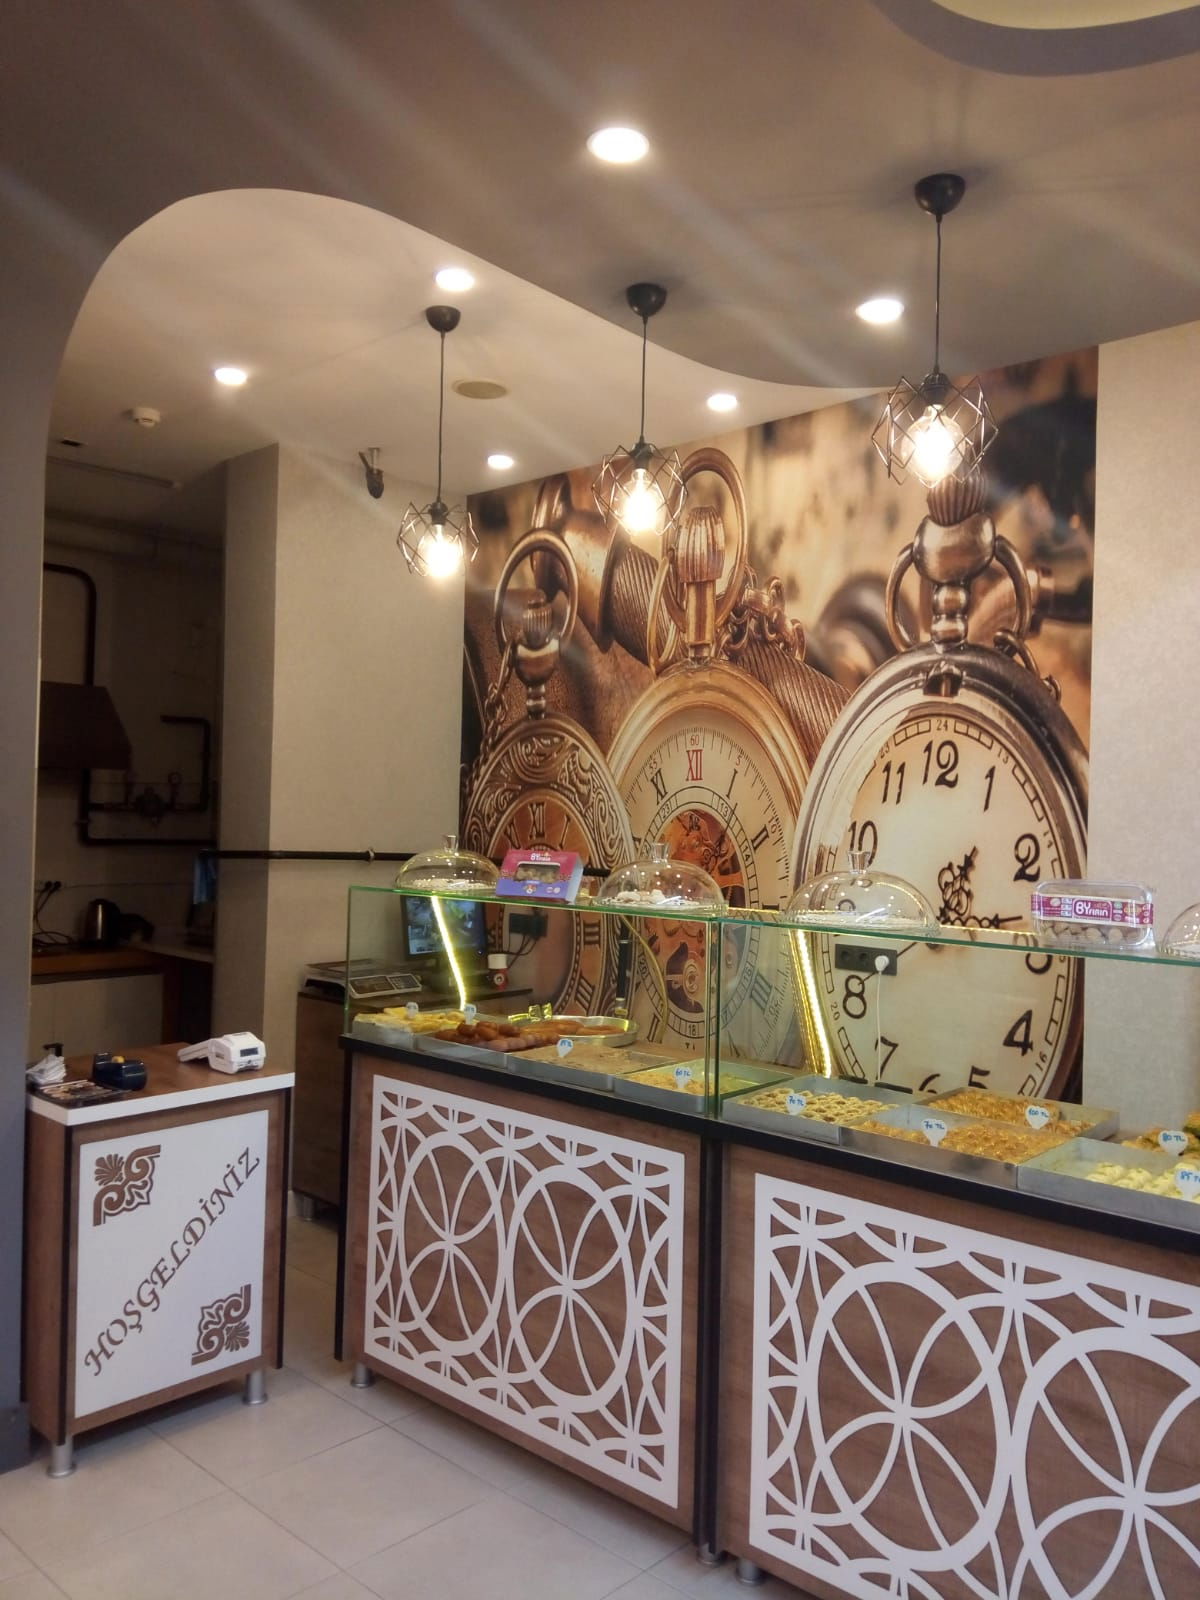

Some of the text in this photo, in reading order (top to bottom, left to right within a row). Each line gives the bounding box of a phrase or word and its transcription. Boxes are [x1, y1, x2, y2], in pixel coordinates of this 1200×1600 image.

[690, 735, 700, 746] 60
[936, 719, 949, 731] 24
[686, 749, 703, 781] XII
[735, 754, 743, 766] 5
[923, 740, 959, 788] 12
[650, 768, 668, 805] XI
[881, 760, 906, 805] 11
[983, 765, 996, 812] 1
[528, 802, 546, 840] XII
[1013, 833, 1041, 882] 2
[842, 974, 867, 1019] 8
[1002, 1009, 1034, 1056] 4
[874, 1036, 899, 1080] 7
[84, 1146, 261, 1377] HOŞGELDİNİZ
